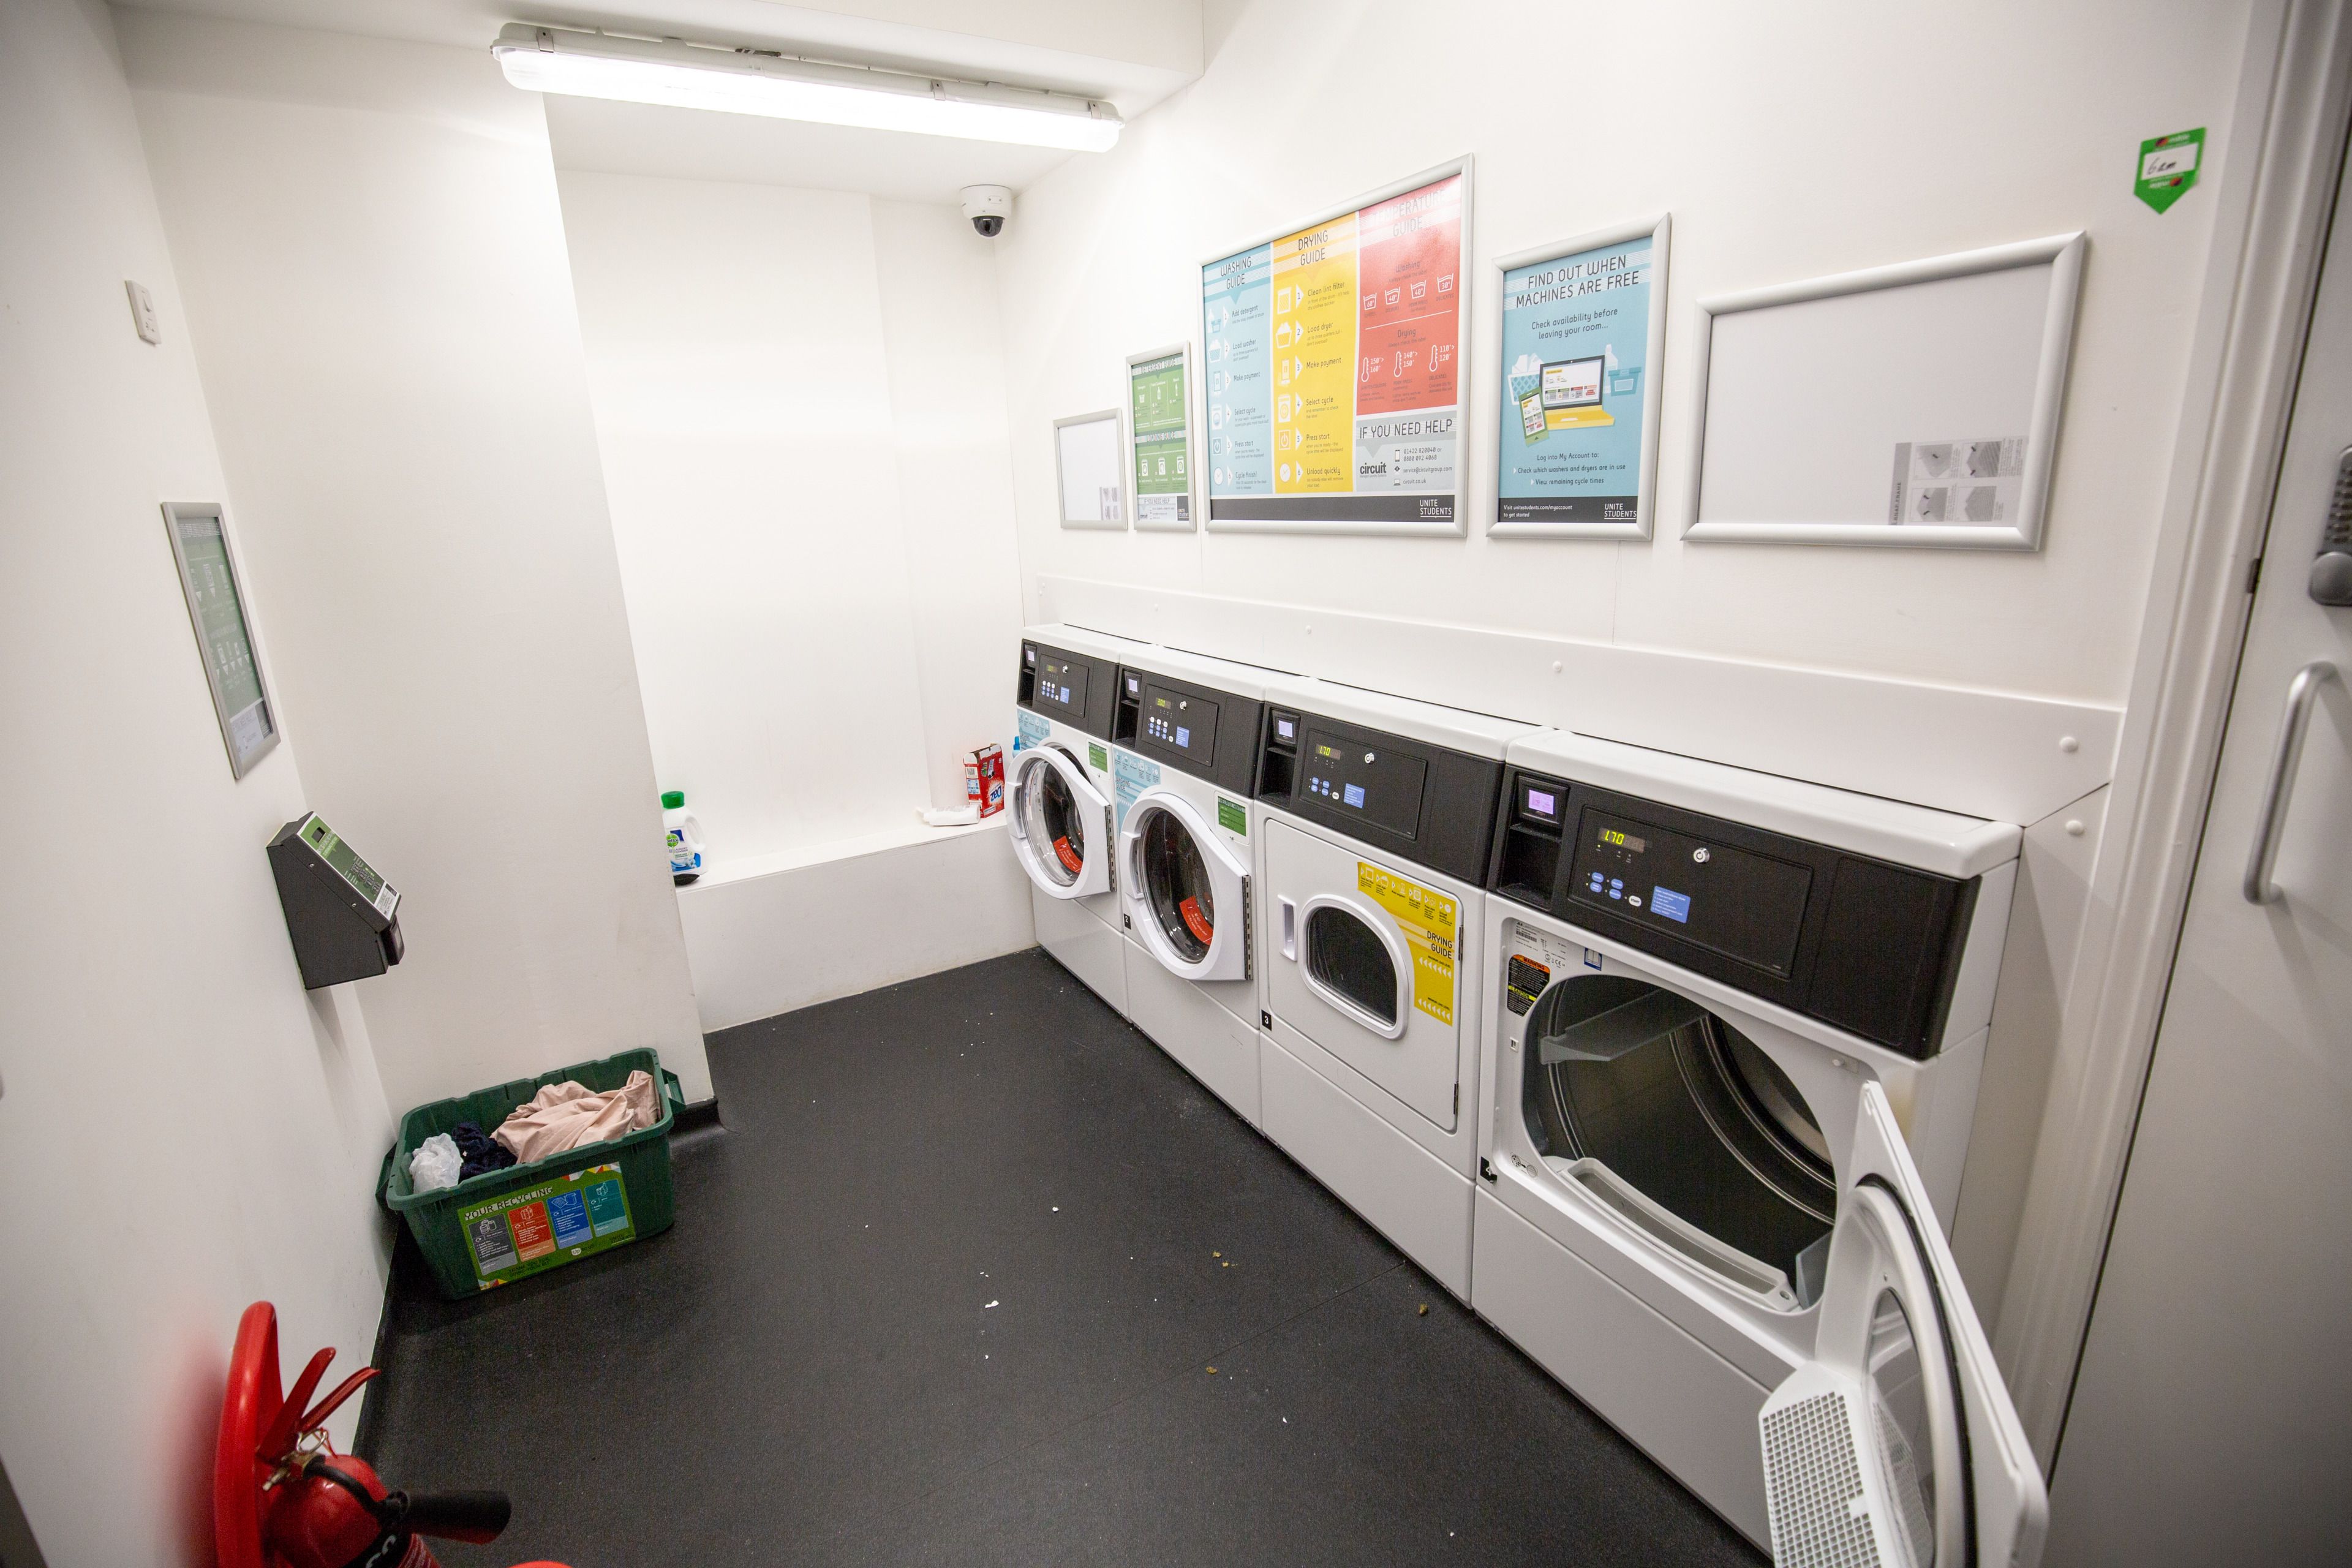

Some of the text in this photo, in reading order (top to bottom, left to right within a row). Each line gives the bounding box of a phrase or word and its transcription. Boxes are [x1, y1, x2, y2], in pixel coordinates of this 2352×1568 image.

[1393, 216, 1423, 237] GUIDE
[1298, 230, 1328, 251] DRYING
[1300, 248, 1325, 265] GUIDE
[1220, 257, 1251, 276] WASHING
[1396, 261, 1420, 273] Washing
[1528, 255, 1626, 289] FIND OUT WHEN
[1226, 274, 1245, 289] GUIDE
[1333, 282, 1345, 290] filter
[1517, 271, 1640, 308] MACHINES ARE FREE
[1240, 305, 1258, 315] detergent
[1532, 308, 1618, 330] Check availability before
[1321, 322, 1333, 331] dryer
[1398, 329, 1416, 338] Drying
[1539, 323, 1608, 339] leaving your room...
[1321, 358, 1341, 368] payment
[1244, 371, 1260, 380] payment
[1322, 396, 1333, 405] cycle
[1360, 419, 1452, 439] IF YOU NEED HELP
[1325, 467, 1340, 475] quickly
[1360, 462, 1386, 474] circuit
[1319, 745, 1331, 756] 1.70
[990, 785, 1001, 802] Daz
[1604, 830, 1624, 845] 1.70
[1427, 931, 1452, 949] DRYING
[1431, 943, 1452, 959] GUIDE
[1523, 957, 1545, 970] WARNING
[1513, 987, 1530, 999] CAUTION
[1264, 1016, 1268, 1024] 3
[1486, 1166, 1491, 1176] 4
[464, 1186, 553, 1220] YOUR RECYCLING
